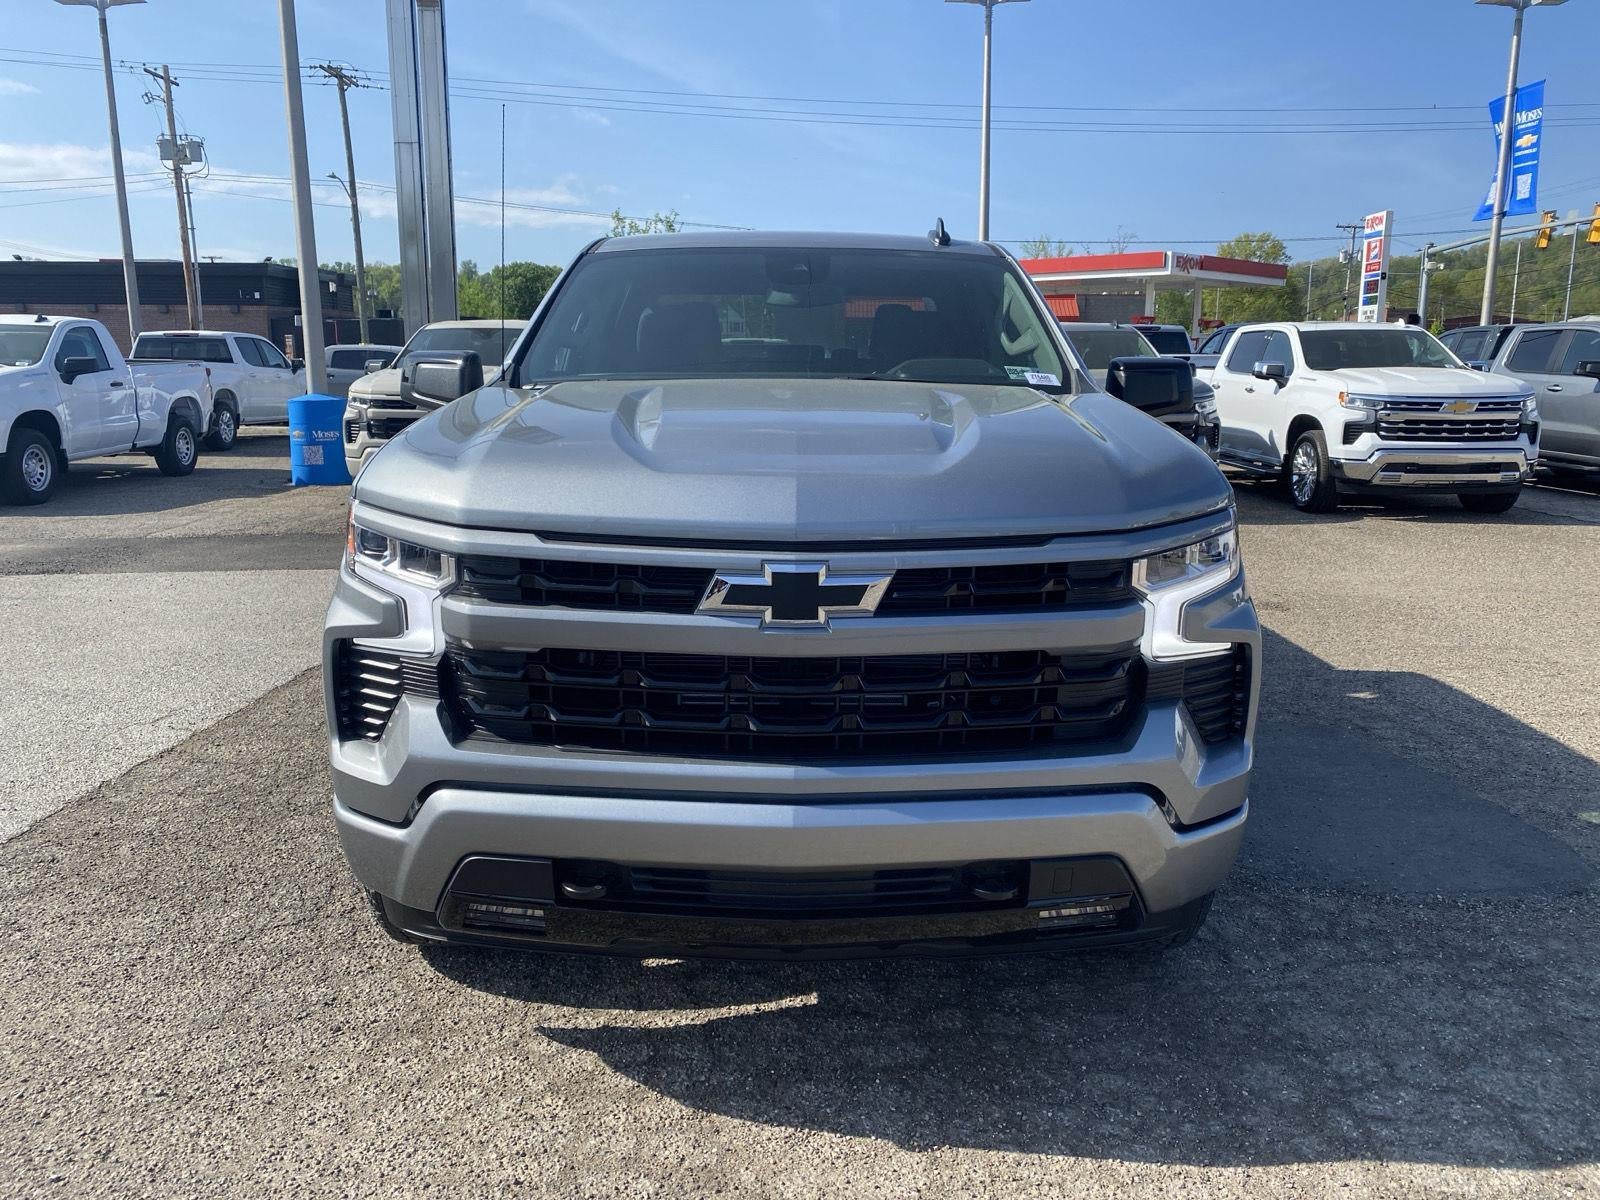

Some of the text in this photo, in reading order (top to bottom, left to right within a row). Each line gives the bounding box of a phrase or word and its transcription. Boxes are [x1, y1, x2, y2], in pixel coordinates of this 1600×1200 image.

[1515, 107, 1543, 125] MOSES
[1365, 214, 1384, 230] EXXON
[1176, 254, 1203, 274] EXXON
[312, 430, 340, 439] MOSES
